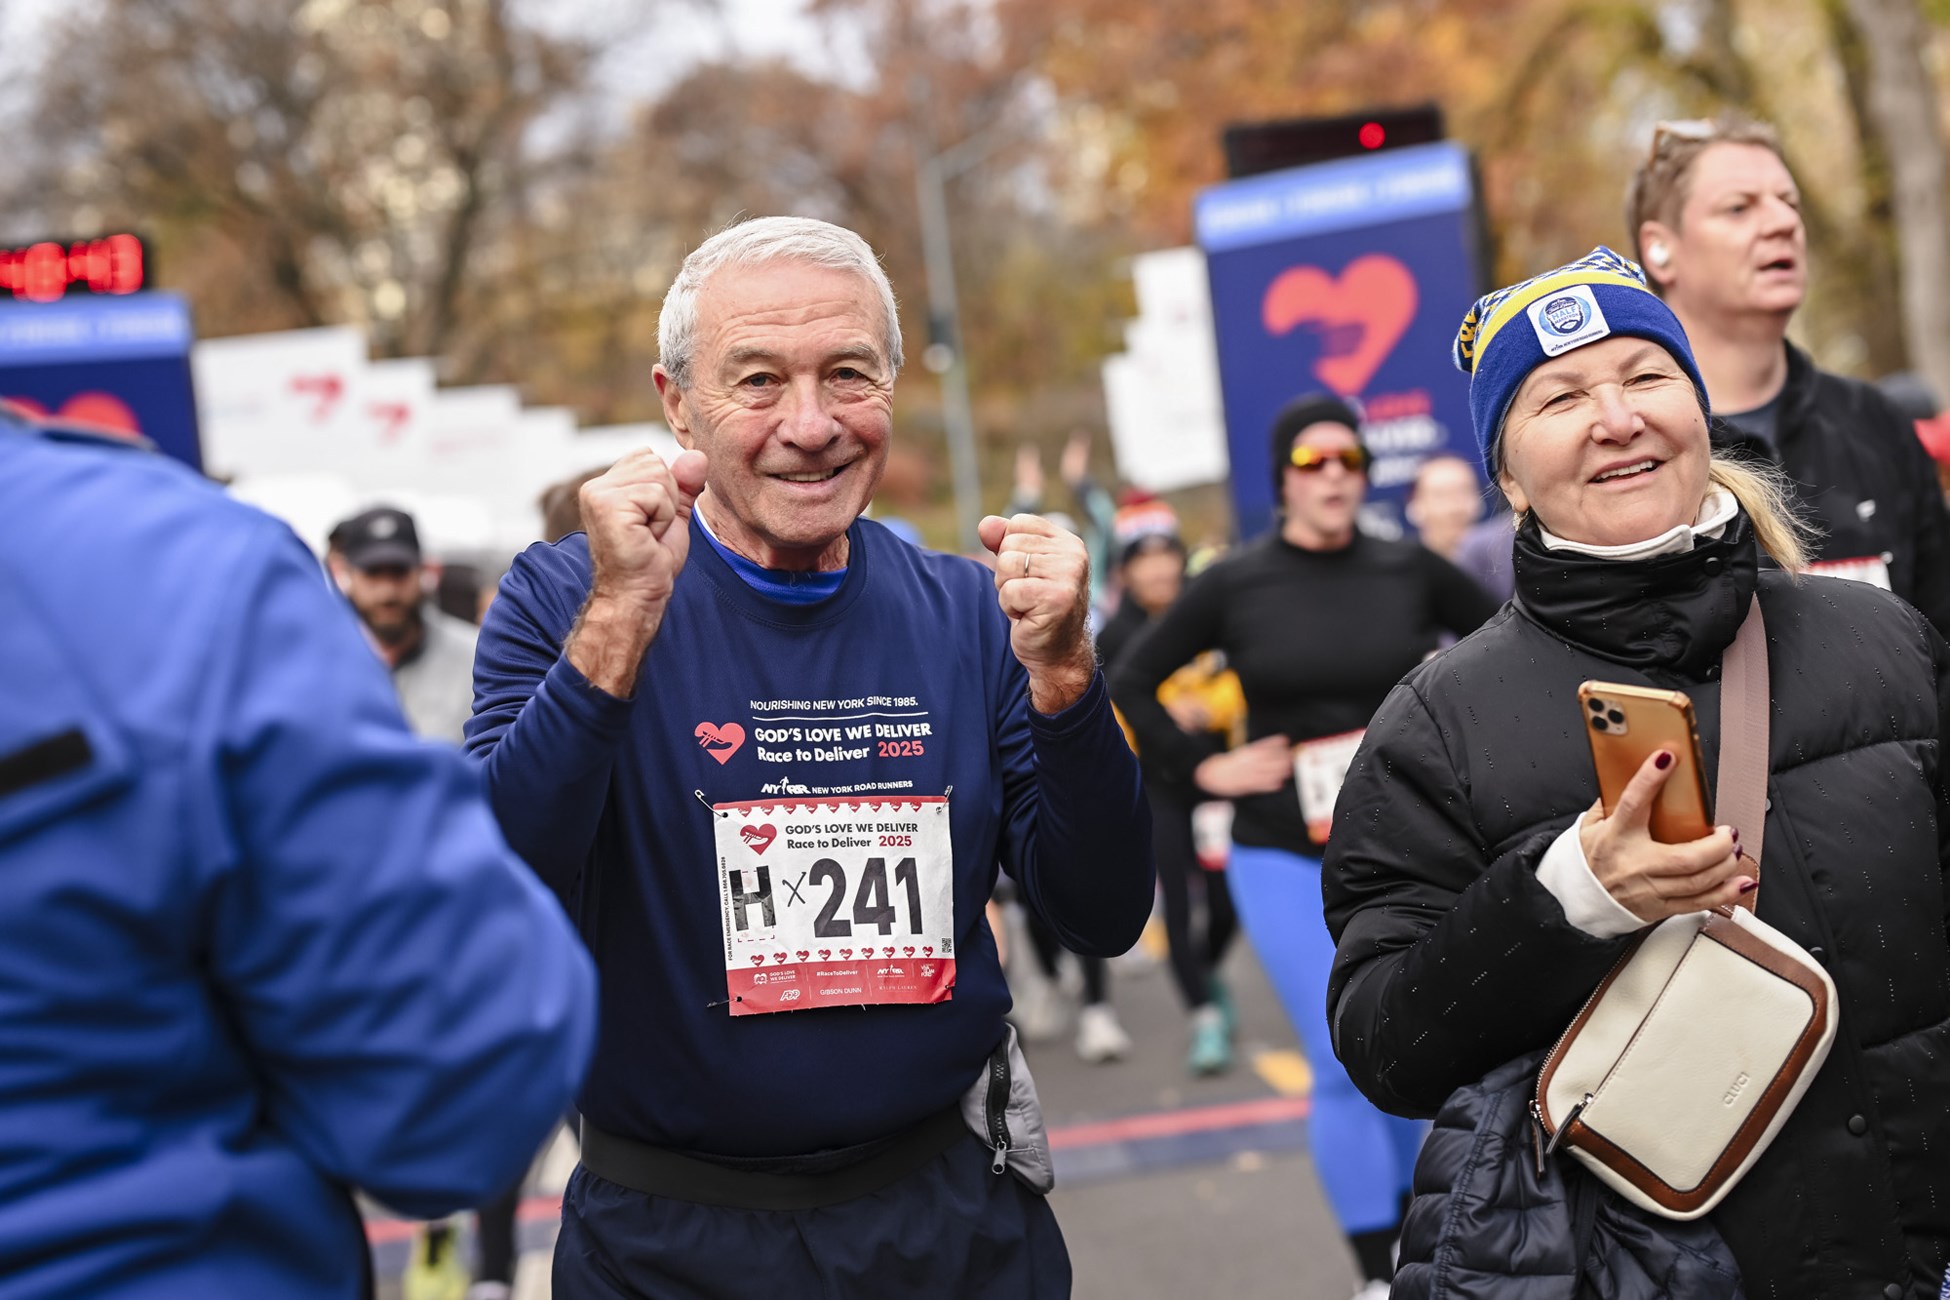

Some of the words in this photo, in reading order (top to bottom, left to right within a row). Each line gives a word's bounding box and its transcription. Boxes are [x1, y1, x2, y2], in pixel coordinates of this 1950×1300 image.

[1552, 306, 1576, 320] HALF
[750, 700, 811, 710] NOURISHING
[813, 700, 836, 710] NEW
[838, 698, 865, 709] YORK
[866, 696, 892, 706] SINCE
[893, 696, 918, 707] 1985.
[754, 728, 802, 742] GOD'S
[805, 728, 842, 741] LOVE
[845, 724, 872, 739] WE
[875, 722, 932, 738] DELIVER
[757, 746, 792, 762] Race
[796, 748, 812, 762] to
[814, 746, 870, 762] Deliver
[877, 740, 924, 758] 2025
[854, 783, 877, 792] ROAD
[878, 780, 913, 790] RUNNERS
[785, 824, 822, 834] GOD'S
[825, 824, 852, 833] LOVE
[856, 824, 873, 832] WE
[876, 823, 918, 832] DELIVER
[787, 839, 814, 849] Race
[818, 839, 829, 848] to
[832, 837, 871, 847] Deliver
[879, 835, 912, 847] 2025
[729, 865, 776, 931] H
[809, 857, 923, 938] 241
[780, 989, 800, 1001] ADP
[1722, 1071, 1750, 1105] CLUCI
